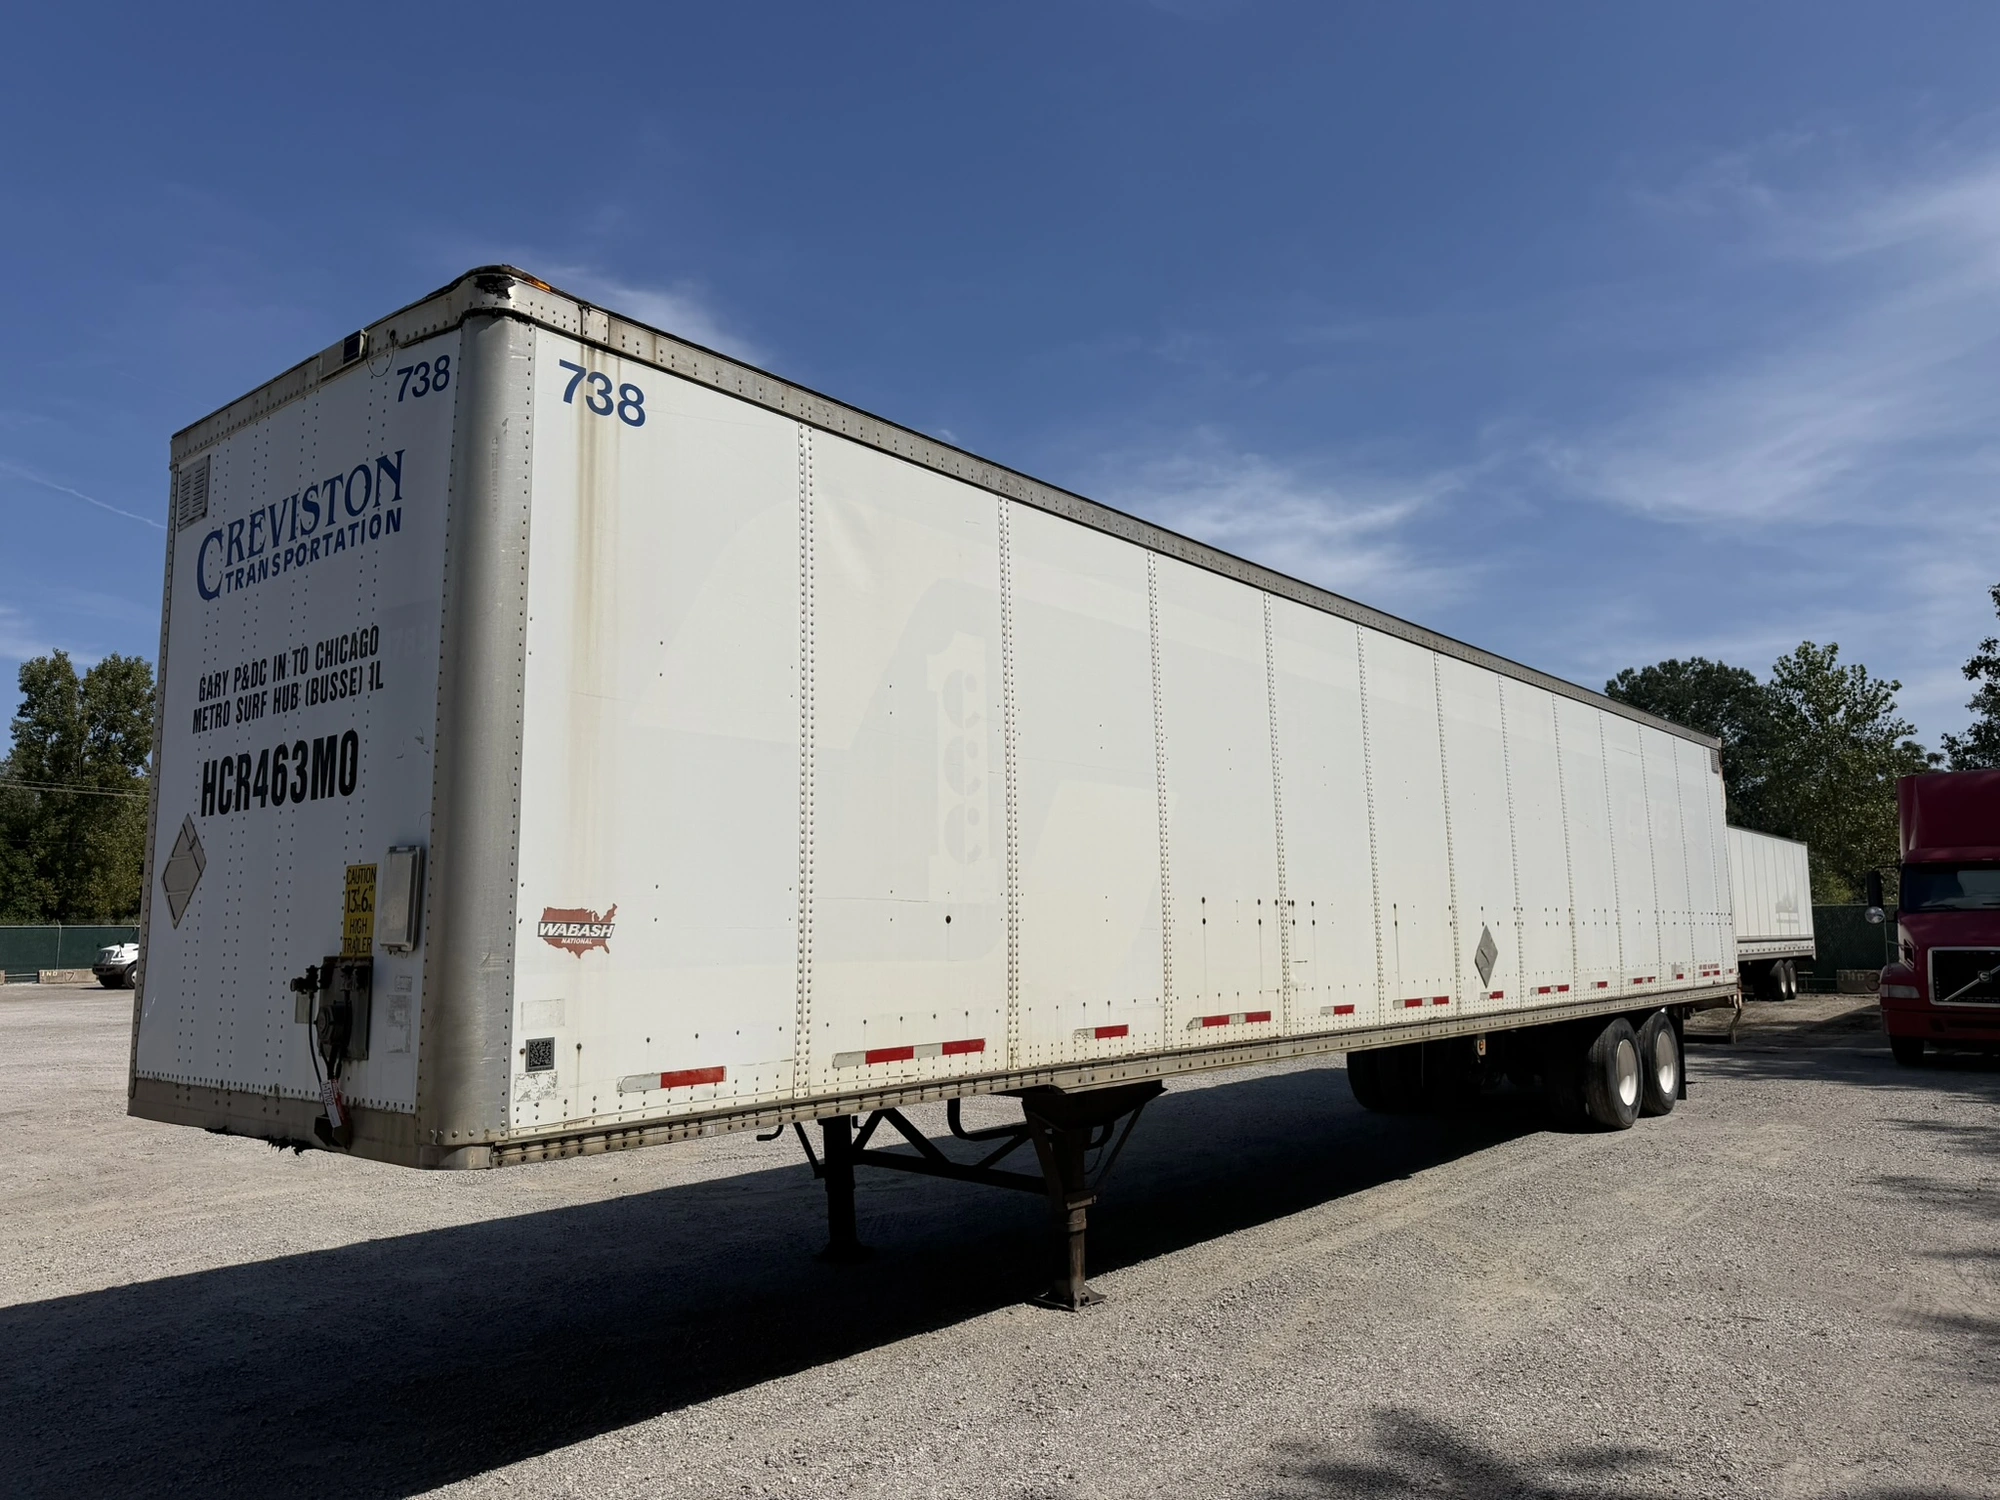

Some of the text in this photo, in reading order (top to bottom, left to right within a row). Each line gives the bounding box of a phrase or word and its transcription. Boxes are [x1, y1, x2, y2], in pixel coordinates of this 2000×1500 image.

[397, 355, 450, 402] 738
[559, 359, 646, 427] 738
[196, 449, 405, 600] CREVISTON
[224, 507, 402, 593] TRANSPORTATION
[198, 670, 229, 702] GARY
[233, 658, 267, 693] P&DC
[272, 653, 287, 682] IN
[292, 646, 309, 677] TO
[315, 625, 379, 671] CHICAGO
[192, 700, 230, 734] METRO
[235, 690, 268, 724] SURF
[273, 682, 299, 715] HUB
[305, 665, 363, 707] (BUSSE)
[346, 867, 377, 885] CAUTION
[343, 937, 372, 954] TRAILER
[349, 918, 368, 934] HIGH
[539, 923, 614, 937] WABASH
